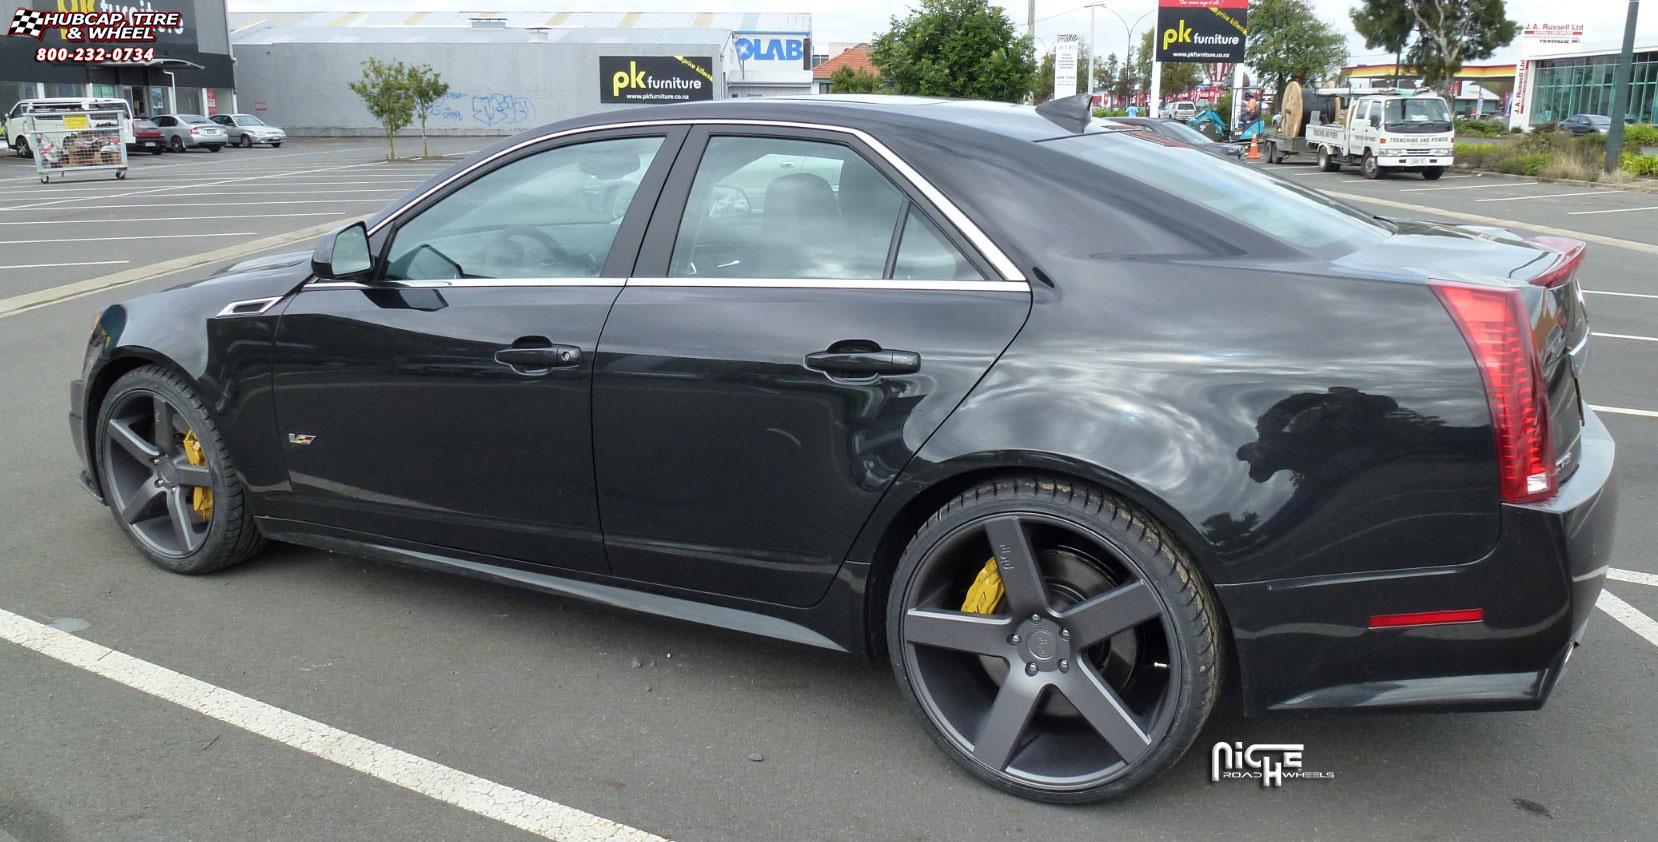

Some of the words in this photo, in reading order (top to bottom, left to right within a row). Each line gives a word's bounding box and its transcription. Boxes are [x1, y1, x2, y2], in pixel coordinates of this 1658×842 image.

[1163, 19, 1193, 50] pk
[1193, 33, 1239, 45] furniture
[613, 61, 646, 97] pk
[647, 76, 702, 89] furniture
